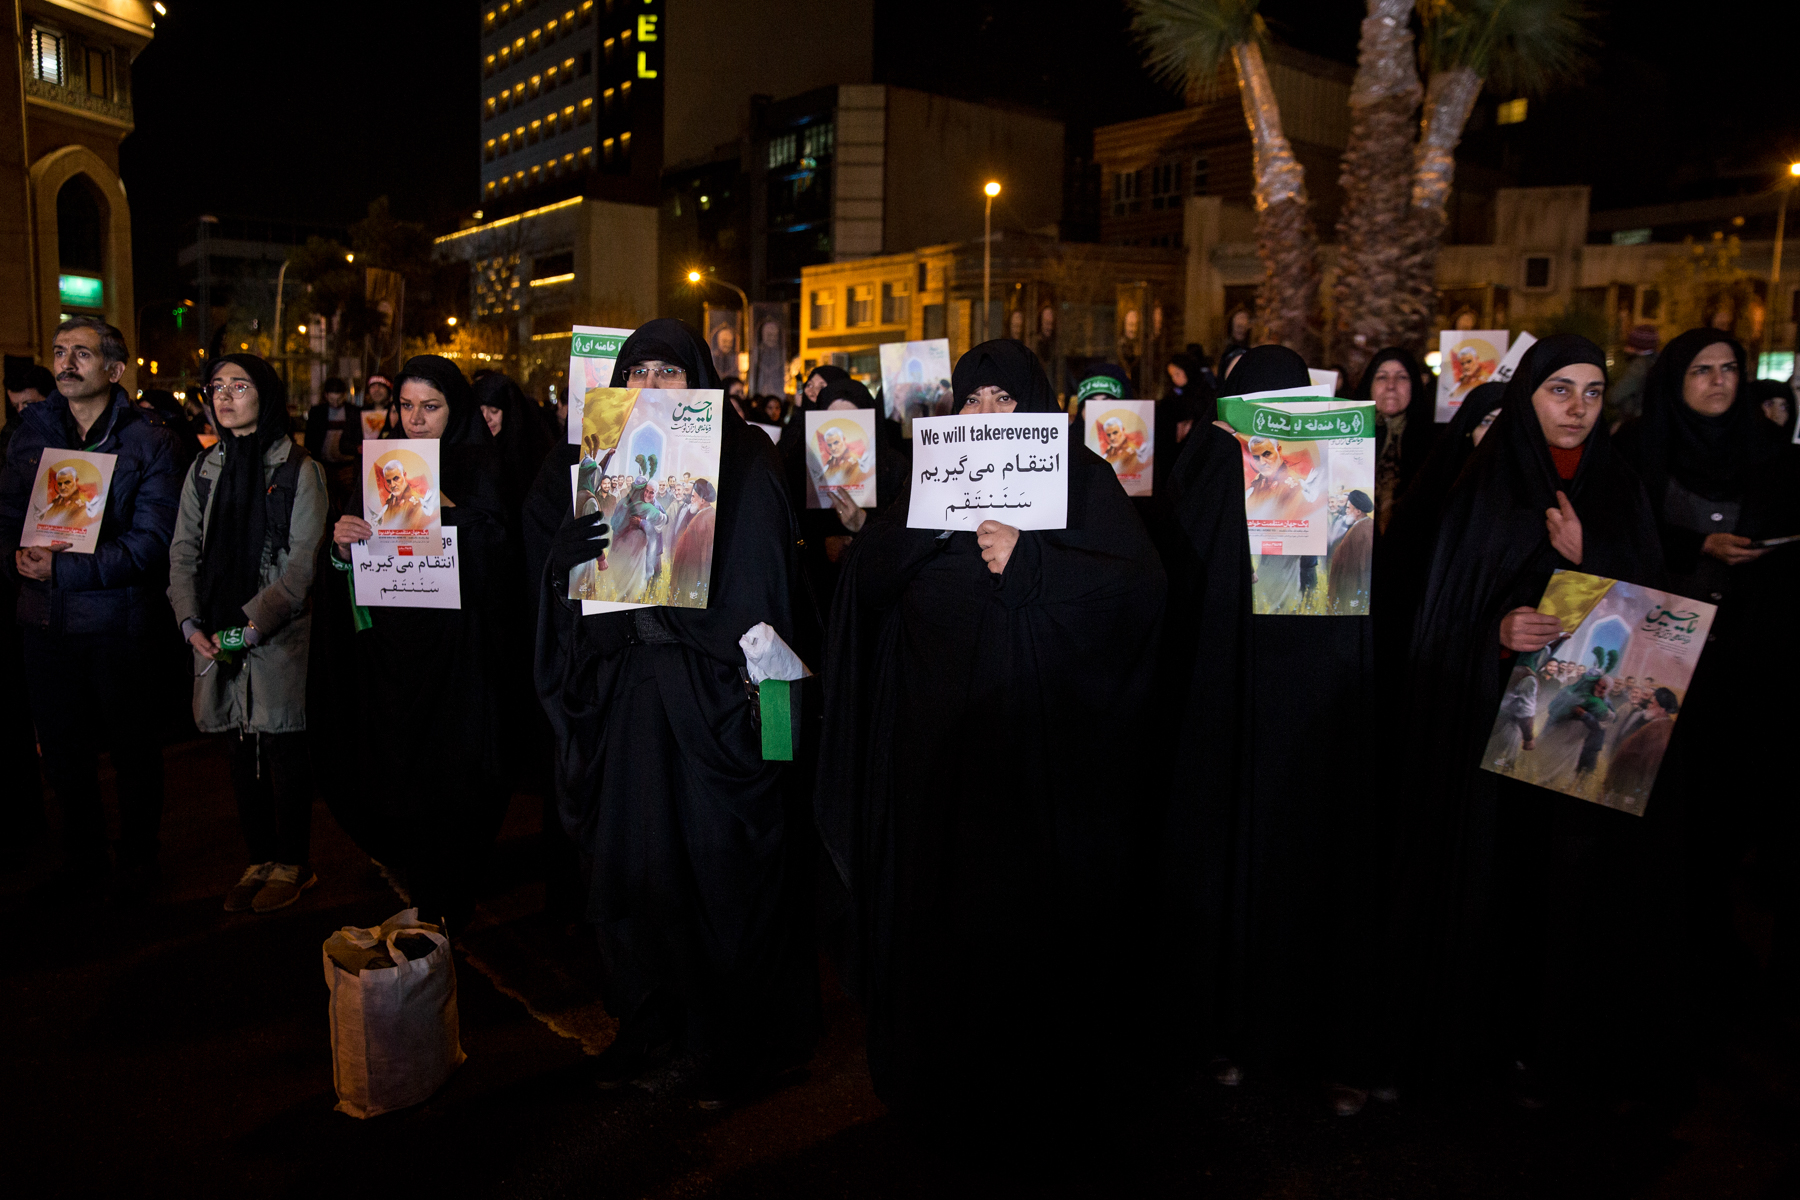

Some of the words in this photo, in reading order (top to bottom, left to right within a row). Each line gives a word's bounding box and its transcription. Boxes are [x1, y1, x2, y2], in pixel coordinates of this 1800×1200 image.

[637, 0, 658, 79] EL
[921, 428, 939, 445] We
[943, 425, 966, 444] will
[970, 424, 1059, 445] takerevenge
[1002, 453, 1060, 480] انتقام
[418, 555, 455, 573] انتقام
